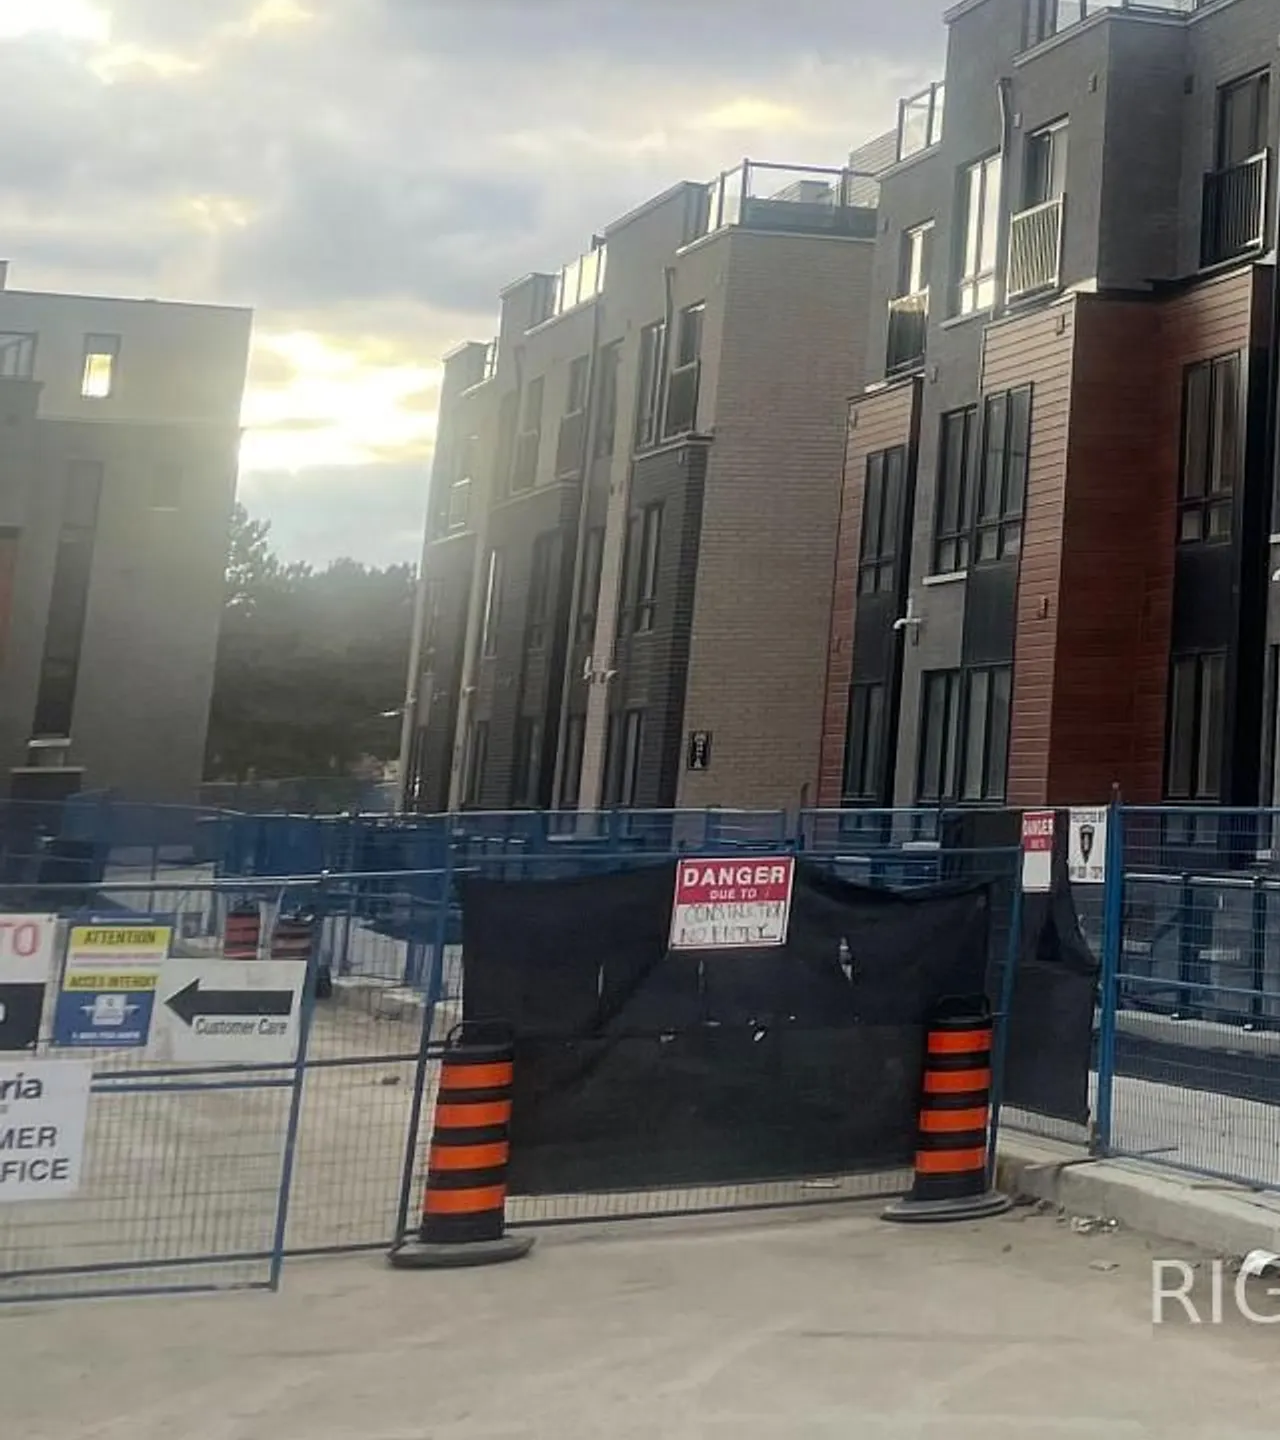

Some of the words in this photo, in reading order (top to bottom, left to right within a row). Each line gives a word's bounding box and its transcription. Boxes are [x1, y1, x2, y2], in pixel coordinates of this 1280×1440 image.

[684, 866, 785, 887] DANGER
[710, 889, 735, 899] DUE
[741, 888, 757, 899] TO
[84, 930, 156, 945] ATTENTION
[196, 1018, 256, 1035] Customer
[258, 1018, 288, 1035] Care
